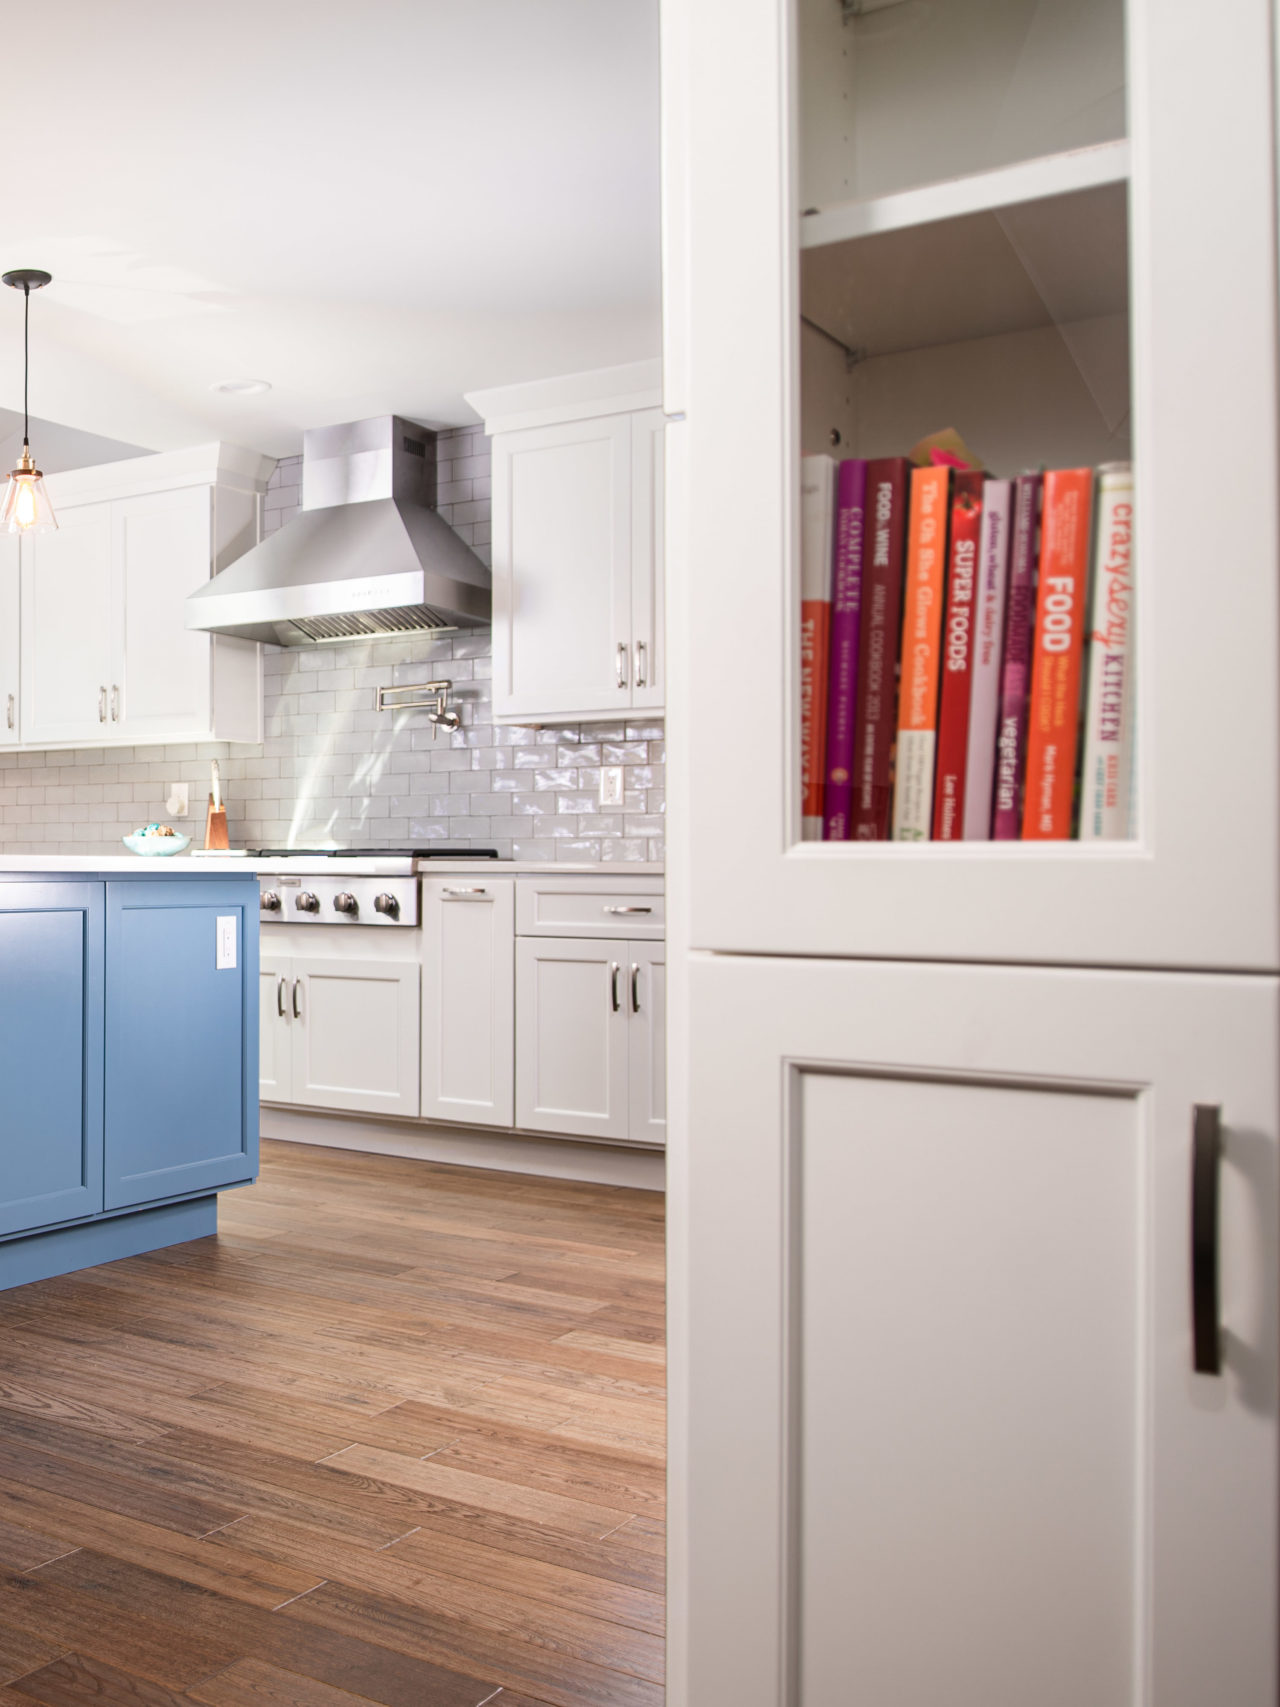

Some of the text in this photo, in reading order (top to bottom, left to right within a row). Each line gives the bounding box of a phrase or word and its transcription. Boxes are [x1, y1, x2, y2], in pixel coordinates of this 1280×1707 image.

[921, 482, 938, 514] The
[920, 518, 936, 544] Oh
[987, 511, 1002, 553] gluten,
[845, 507, 863, 613] COMPLETE
[917, 548, 936, 581] She
[987, 554, 1000, 590] wheat
[871, 584, 886, 627] ANNUAL
[914, 586, 933, 638] Glows
[948, 540, 976, 671] SUPER FOODS
[982, 608, 996, 638] dairy
[1042, 576, 1074, 652] FOOD
[868, 630, 883, 691] COOKBOOK
[981, 642, 993, 665] free
[1042, 655, 1054, 690] Should
[911, 643, 931, 726] Cookbook
[1054, 655, 1069, 726] What the Heck
[1099, 654, 1125, 743] KITCHEN
[998, 717, 1018, 810] vegetarian
[1039, 745, 1058, 832] Mark Hyman, MD
[941, 774, 957, 841] Lee Holmes
